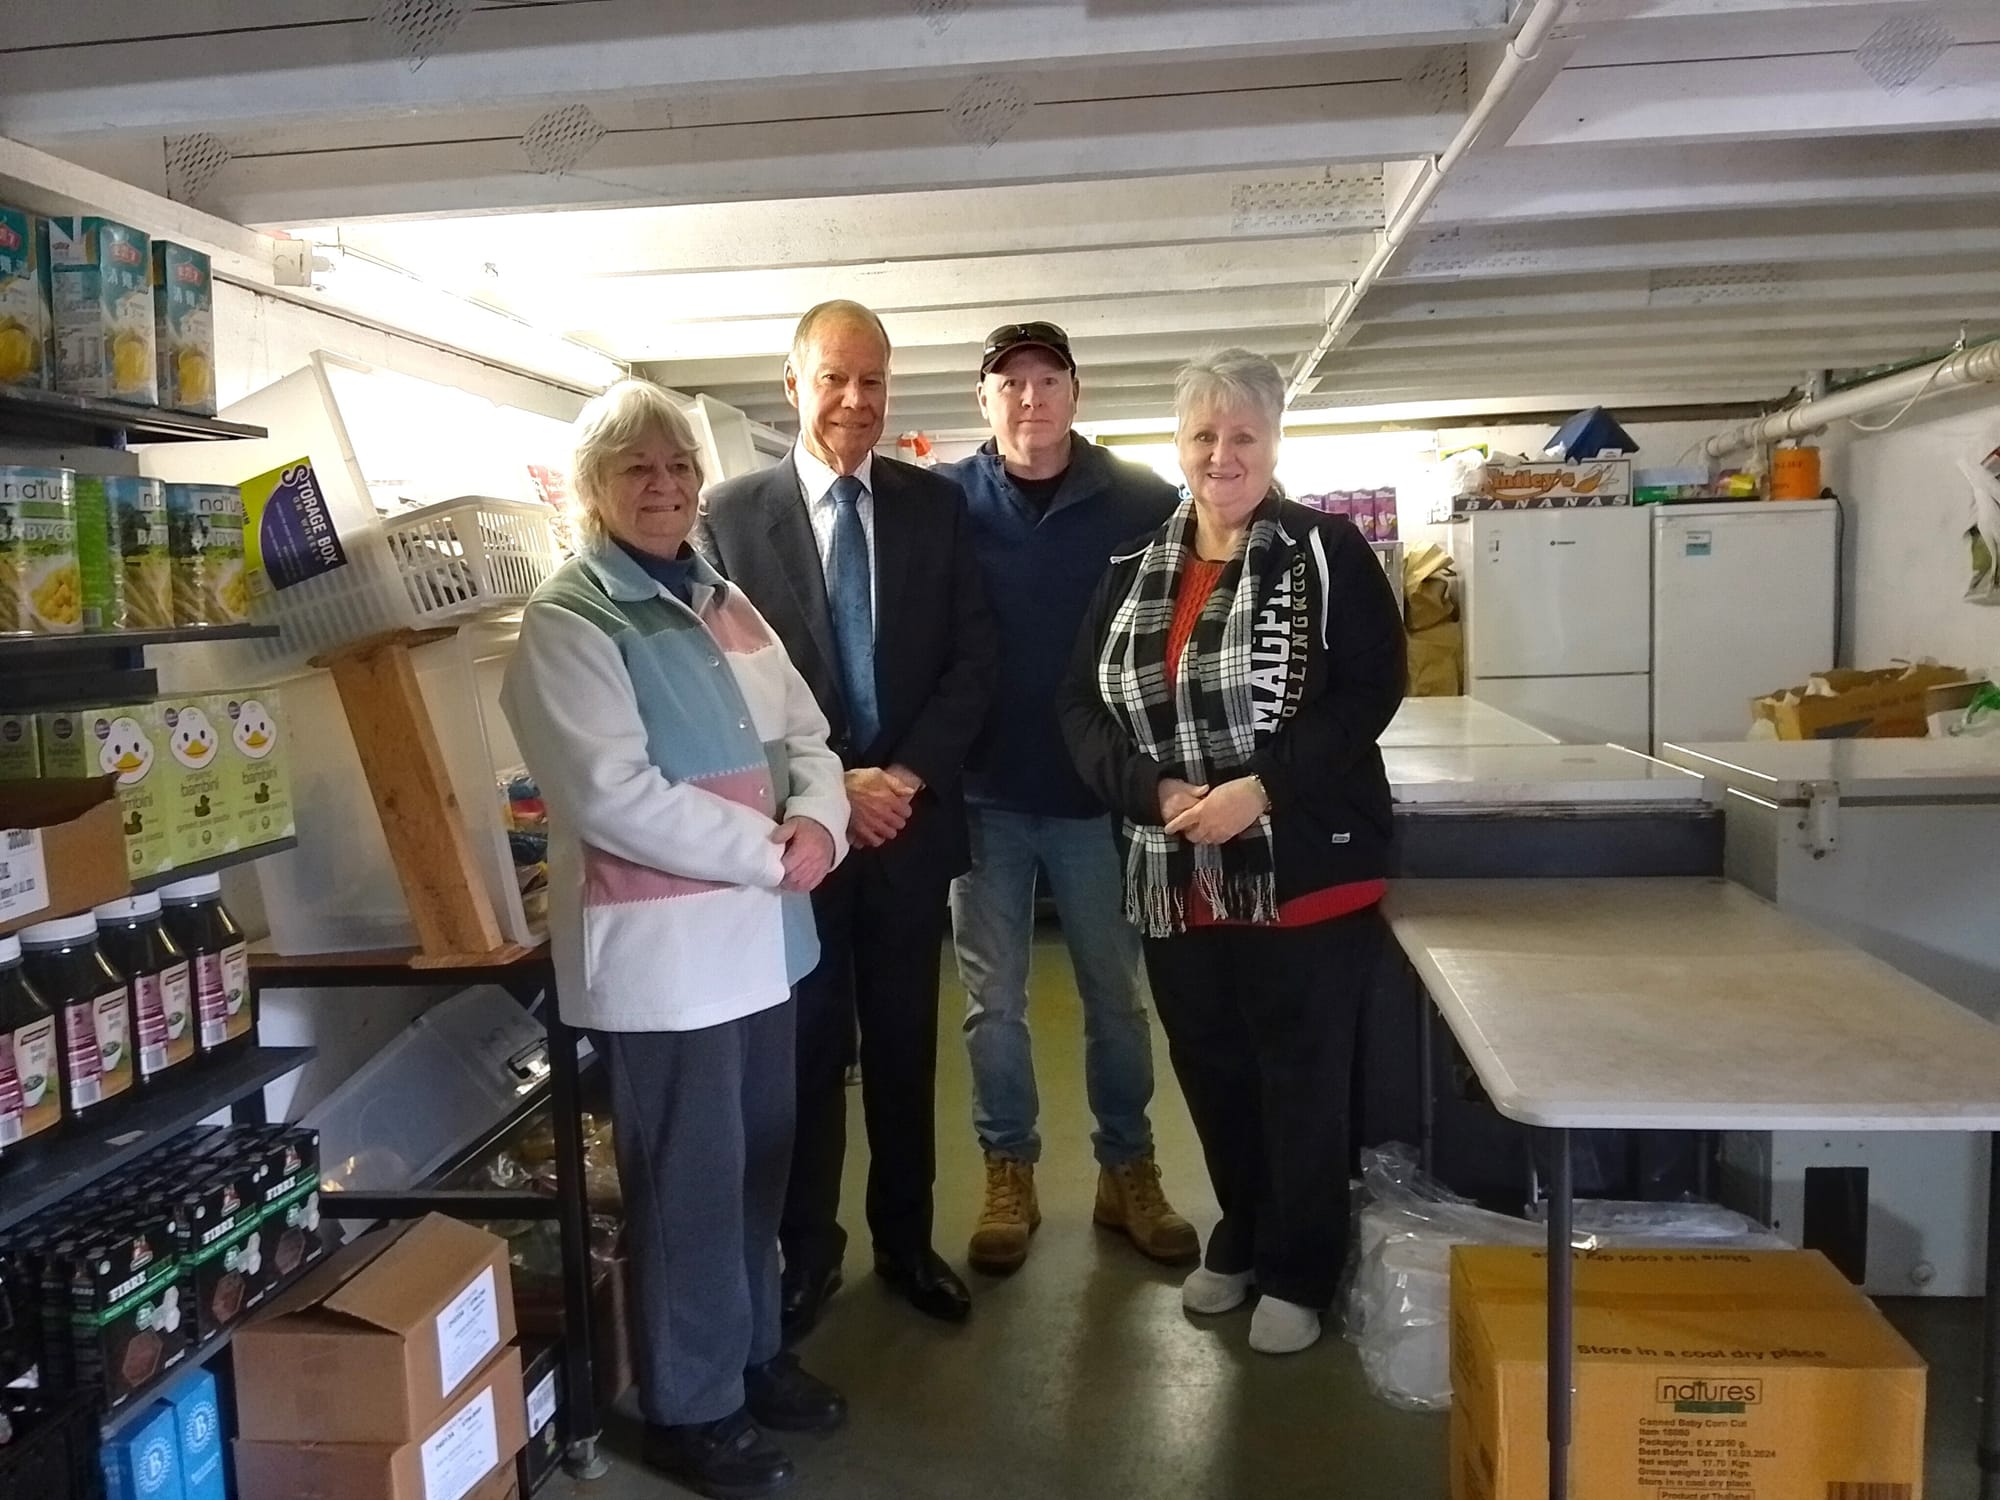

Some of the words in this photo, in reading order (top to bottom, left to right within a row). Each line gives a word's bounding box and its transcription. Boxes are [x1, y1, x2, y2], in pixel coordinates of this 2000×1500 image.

[1465, 495, 1627, 511] BANANAS
[281, 464, 328, 534] STORAGE
[317, 535, 339, 566] BOX
[51, 525, 73, 542] CO
[242, 768, 277, 785] bambini
[181, 777, 219, 797] bambini
[266, 1176, 296, 1201] FIBRE
[202, 1216, 235, 1245] FIBRE
[108, 1270, 147, 1303] FIBRE
[1577, 1344, 1633, 1356] Store
[1636, 1346, 1657, 1357] in
[1663, 1350, 1675, 1358] a
[1681, 1348, 1724, 1359] cool
[1730, 1348, 1764, 1360] dry
[1770, 1349, 1827, 1360] place
[1664, 1381, 1756, 1401] natures
[1638, 1417, 1675, 1427] Canned
[1678, 1418, 1703, 1429] Baby
[1705, 1419, 1728, 1428] Corn
[1730, 1419, 1748, 1428] Cut
[1638, 1437, 1688, 1448] Packaging
[1638, 1447, 1661, 1457] Best
[1663, 1448, 1694, 1458] Before
[1697, 1449, 1718, 1458] Date
[1638, 1458, 1655, 1466] Net
[1657, 1458, 1689, 1468] weight
[1638, 1467, 1667, 1476] Gross
[1669, 1468, 1701, 1478] weight
[1638, 1477, 1663, 1486] Store
[1685, 1478, 1706, 1487] cool
[1708, 1479, 1724, 1489] dry
